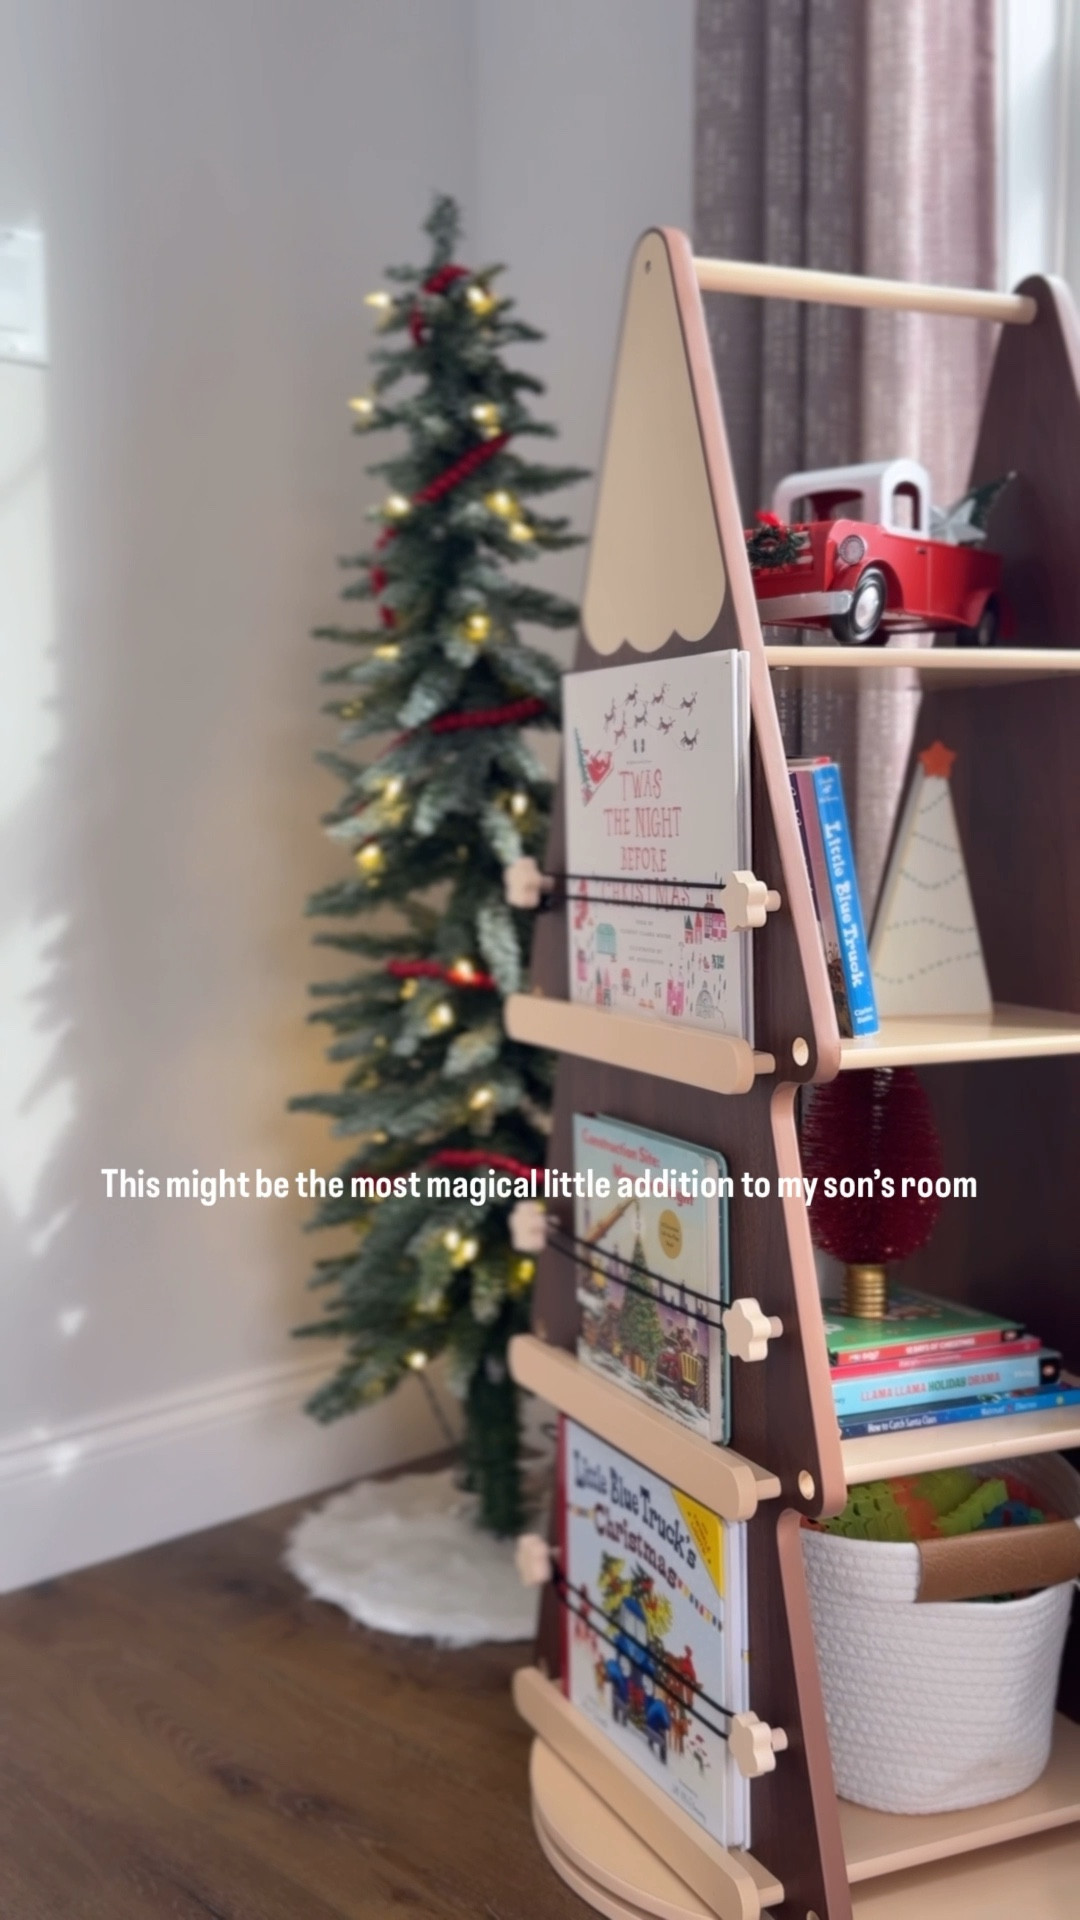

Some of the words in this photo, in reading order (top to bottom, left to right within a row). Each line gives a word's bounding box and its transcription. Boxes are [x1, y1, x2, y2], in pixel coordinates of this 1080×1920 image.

[618, 768, 663, 801] TWAS
[603, 807, 631, 837] THE
[635, 806, 681, 838] NIGHT
[620, 846, 667, 873] BEFORE
[824, 821, 846, 877] Little
[835, 880, 853, 925] Blue
[843, 923, 865, 988] Truck
[861, 1386, 893, 1401] LLAMA
[895, 1383, 927, 1398] LLAMA
[968, 1371, 1001, 1387] DRAMA
[573, 1449, 607, 1495] Little
[609, 1466, 639, 1516] Blue
[639, 1485, 697, 1570] Truck's
[594, 1503, 678, 1590] Christmas
